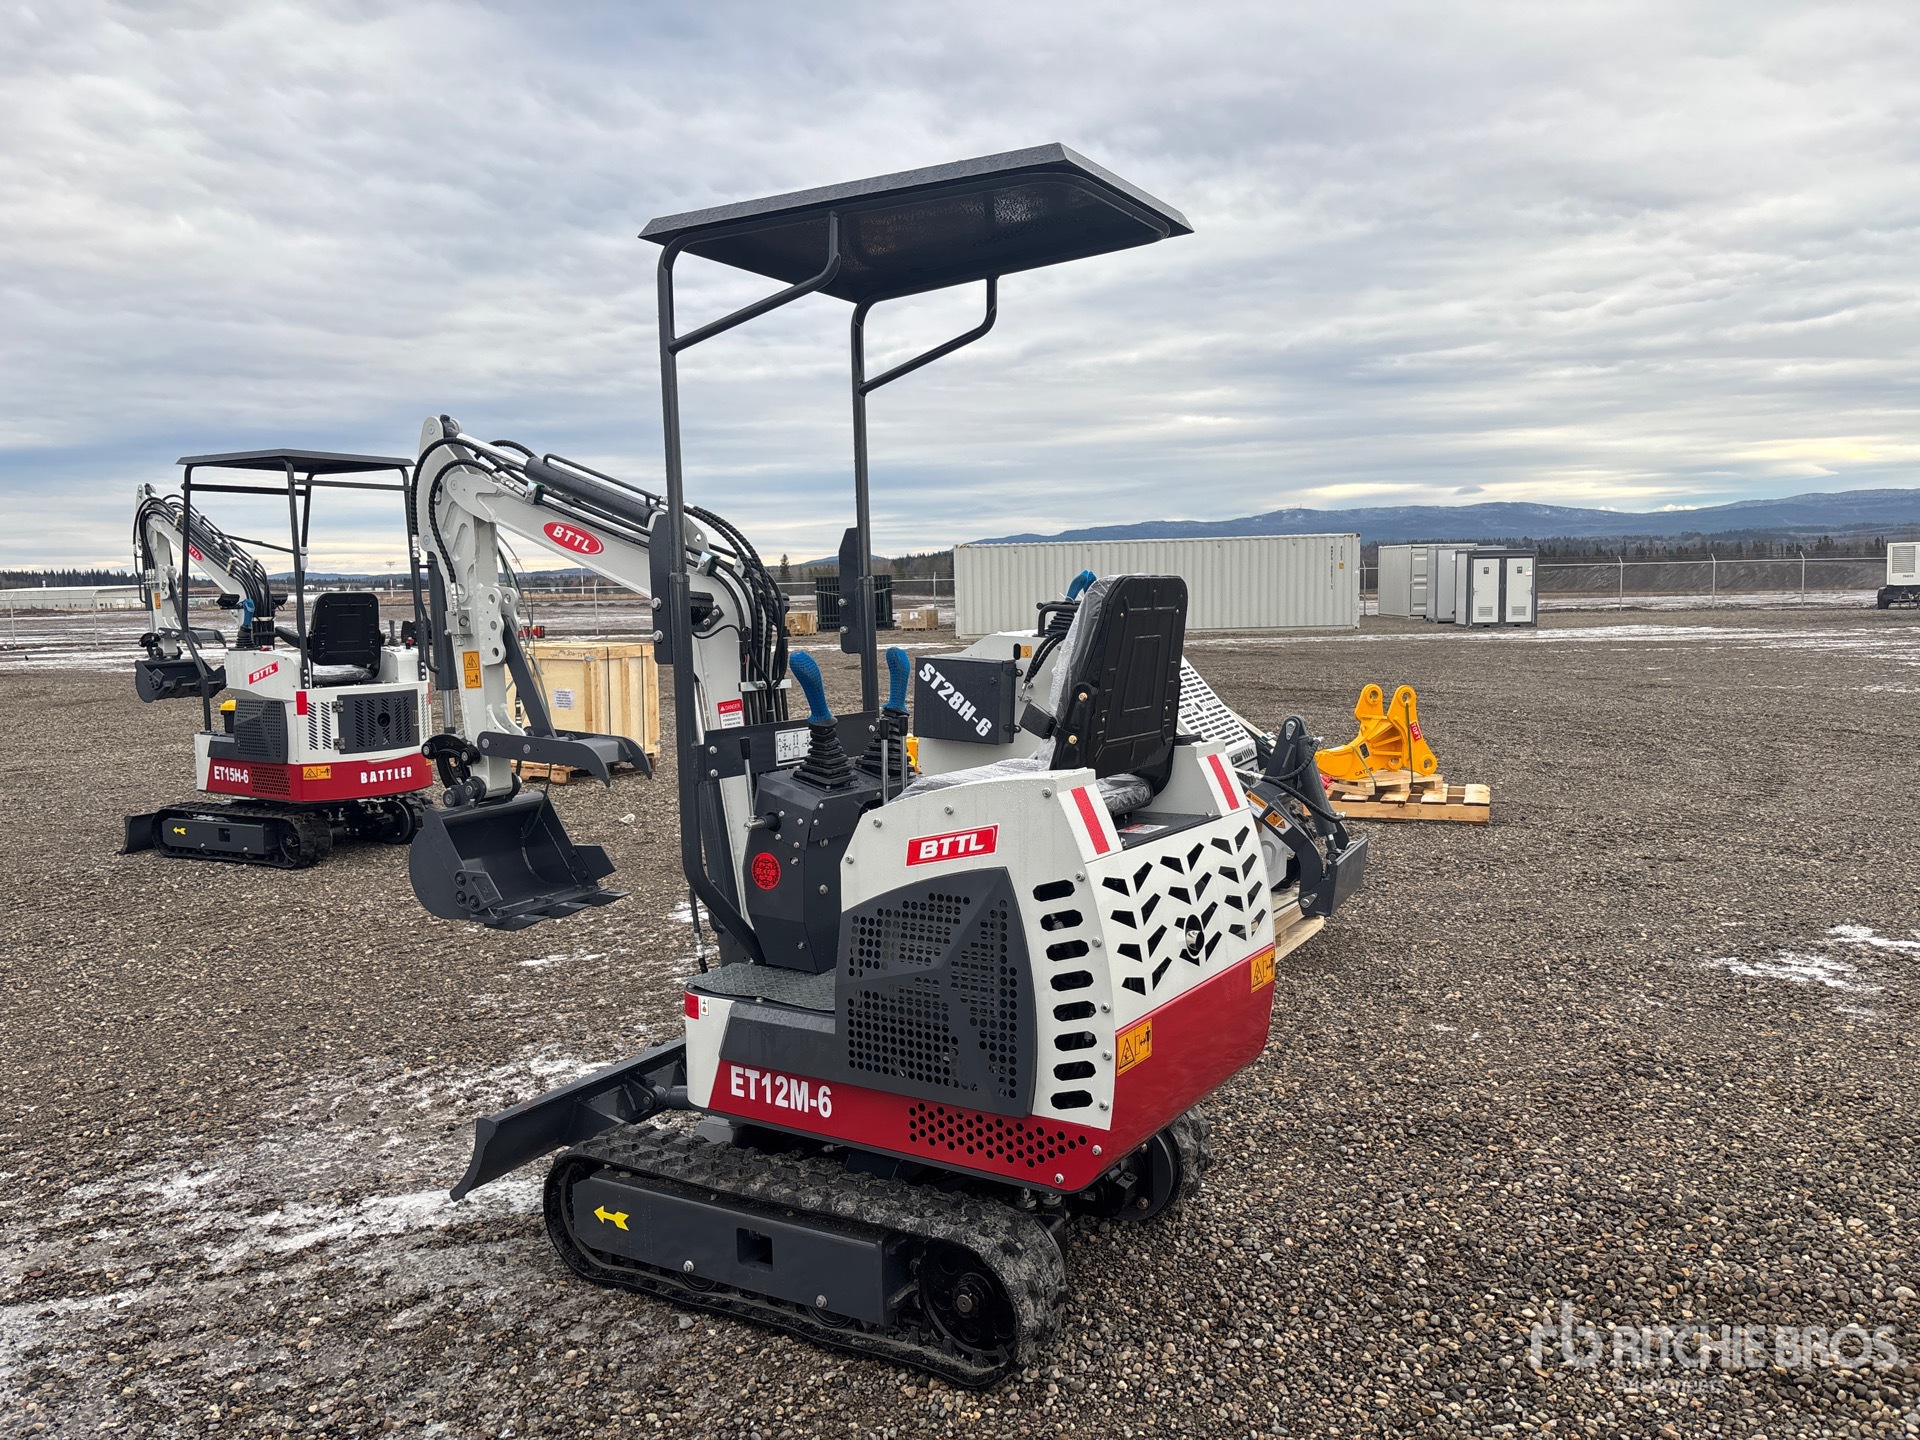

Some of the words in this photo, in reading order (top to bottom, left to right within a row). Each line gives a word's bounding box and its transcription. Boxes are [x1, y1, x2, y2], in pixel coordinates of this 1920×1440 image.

[552, 525, 590, 552] BTTL
[252, 665, 276, 681] BTTL
[918, 662, 993, 738] ST28H-6
[213, 765, 250, 784] ET15H-6
[360, 766, 413, 784] BATTLER
[919, 833, 985, 860] BTTL
[730, 1065, 833, 1119] ET12M-6
